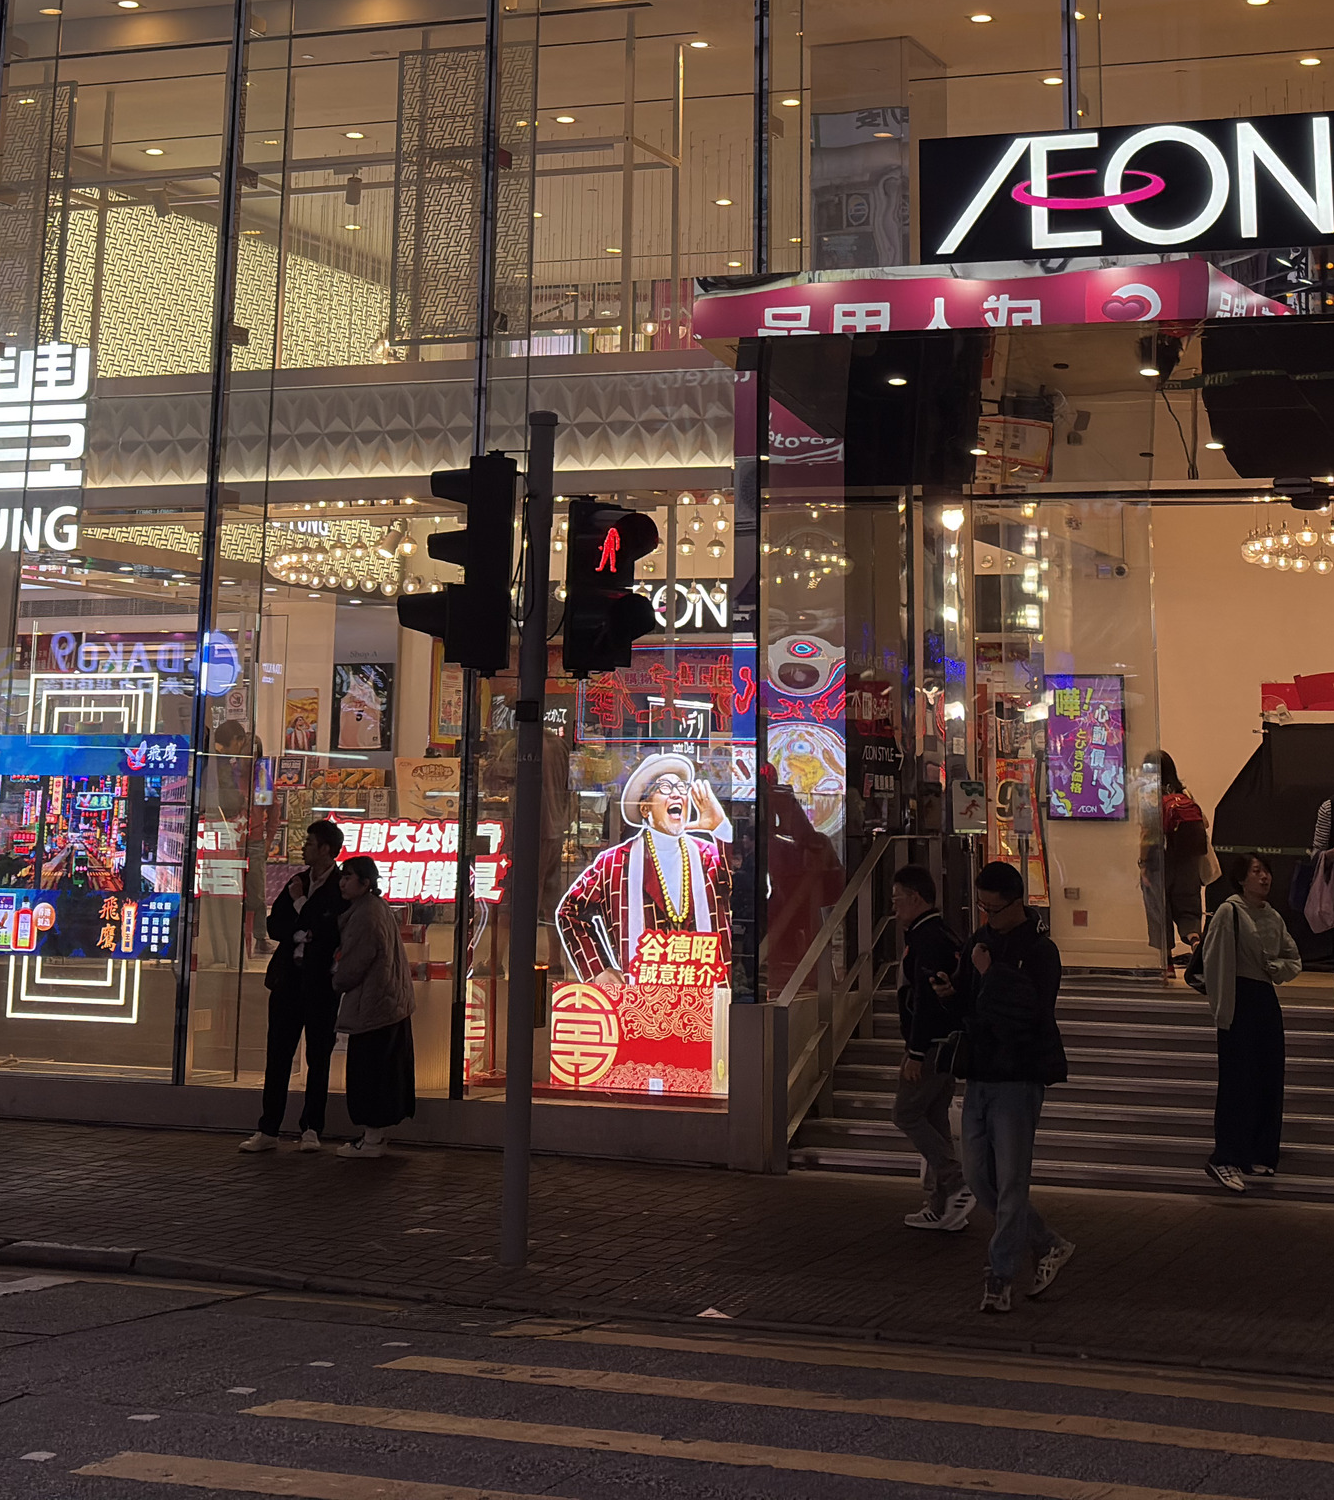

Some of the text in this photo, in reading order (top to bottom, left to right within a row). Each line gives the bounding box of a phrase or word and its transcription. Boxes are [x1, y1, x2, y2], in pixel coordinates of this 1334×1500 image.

[639, 933, 719, 964] 谷德昭
[637, 963, 717, 987] 誠意推介
